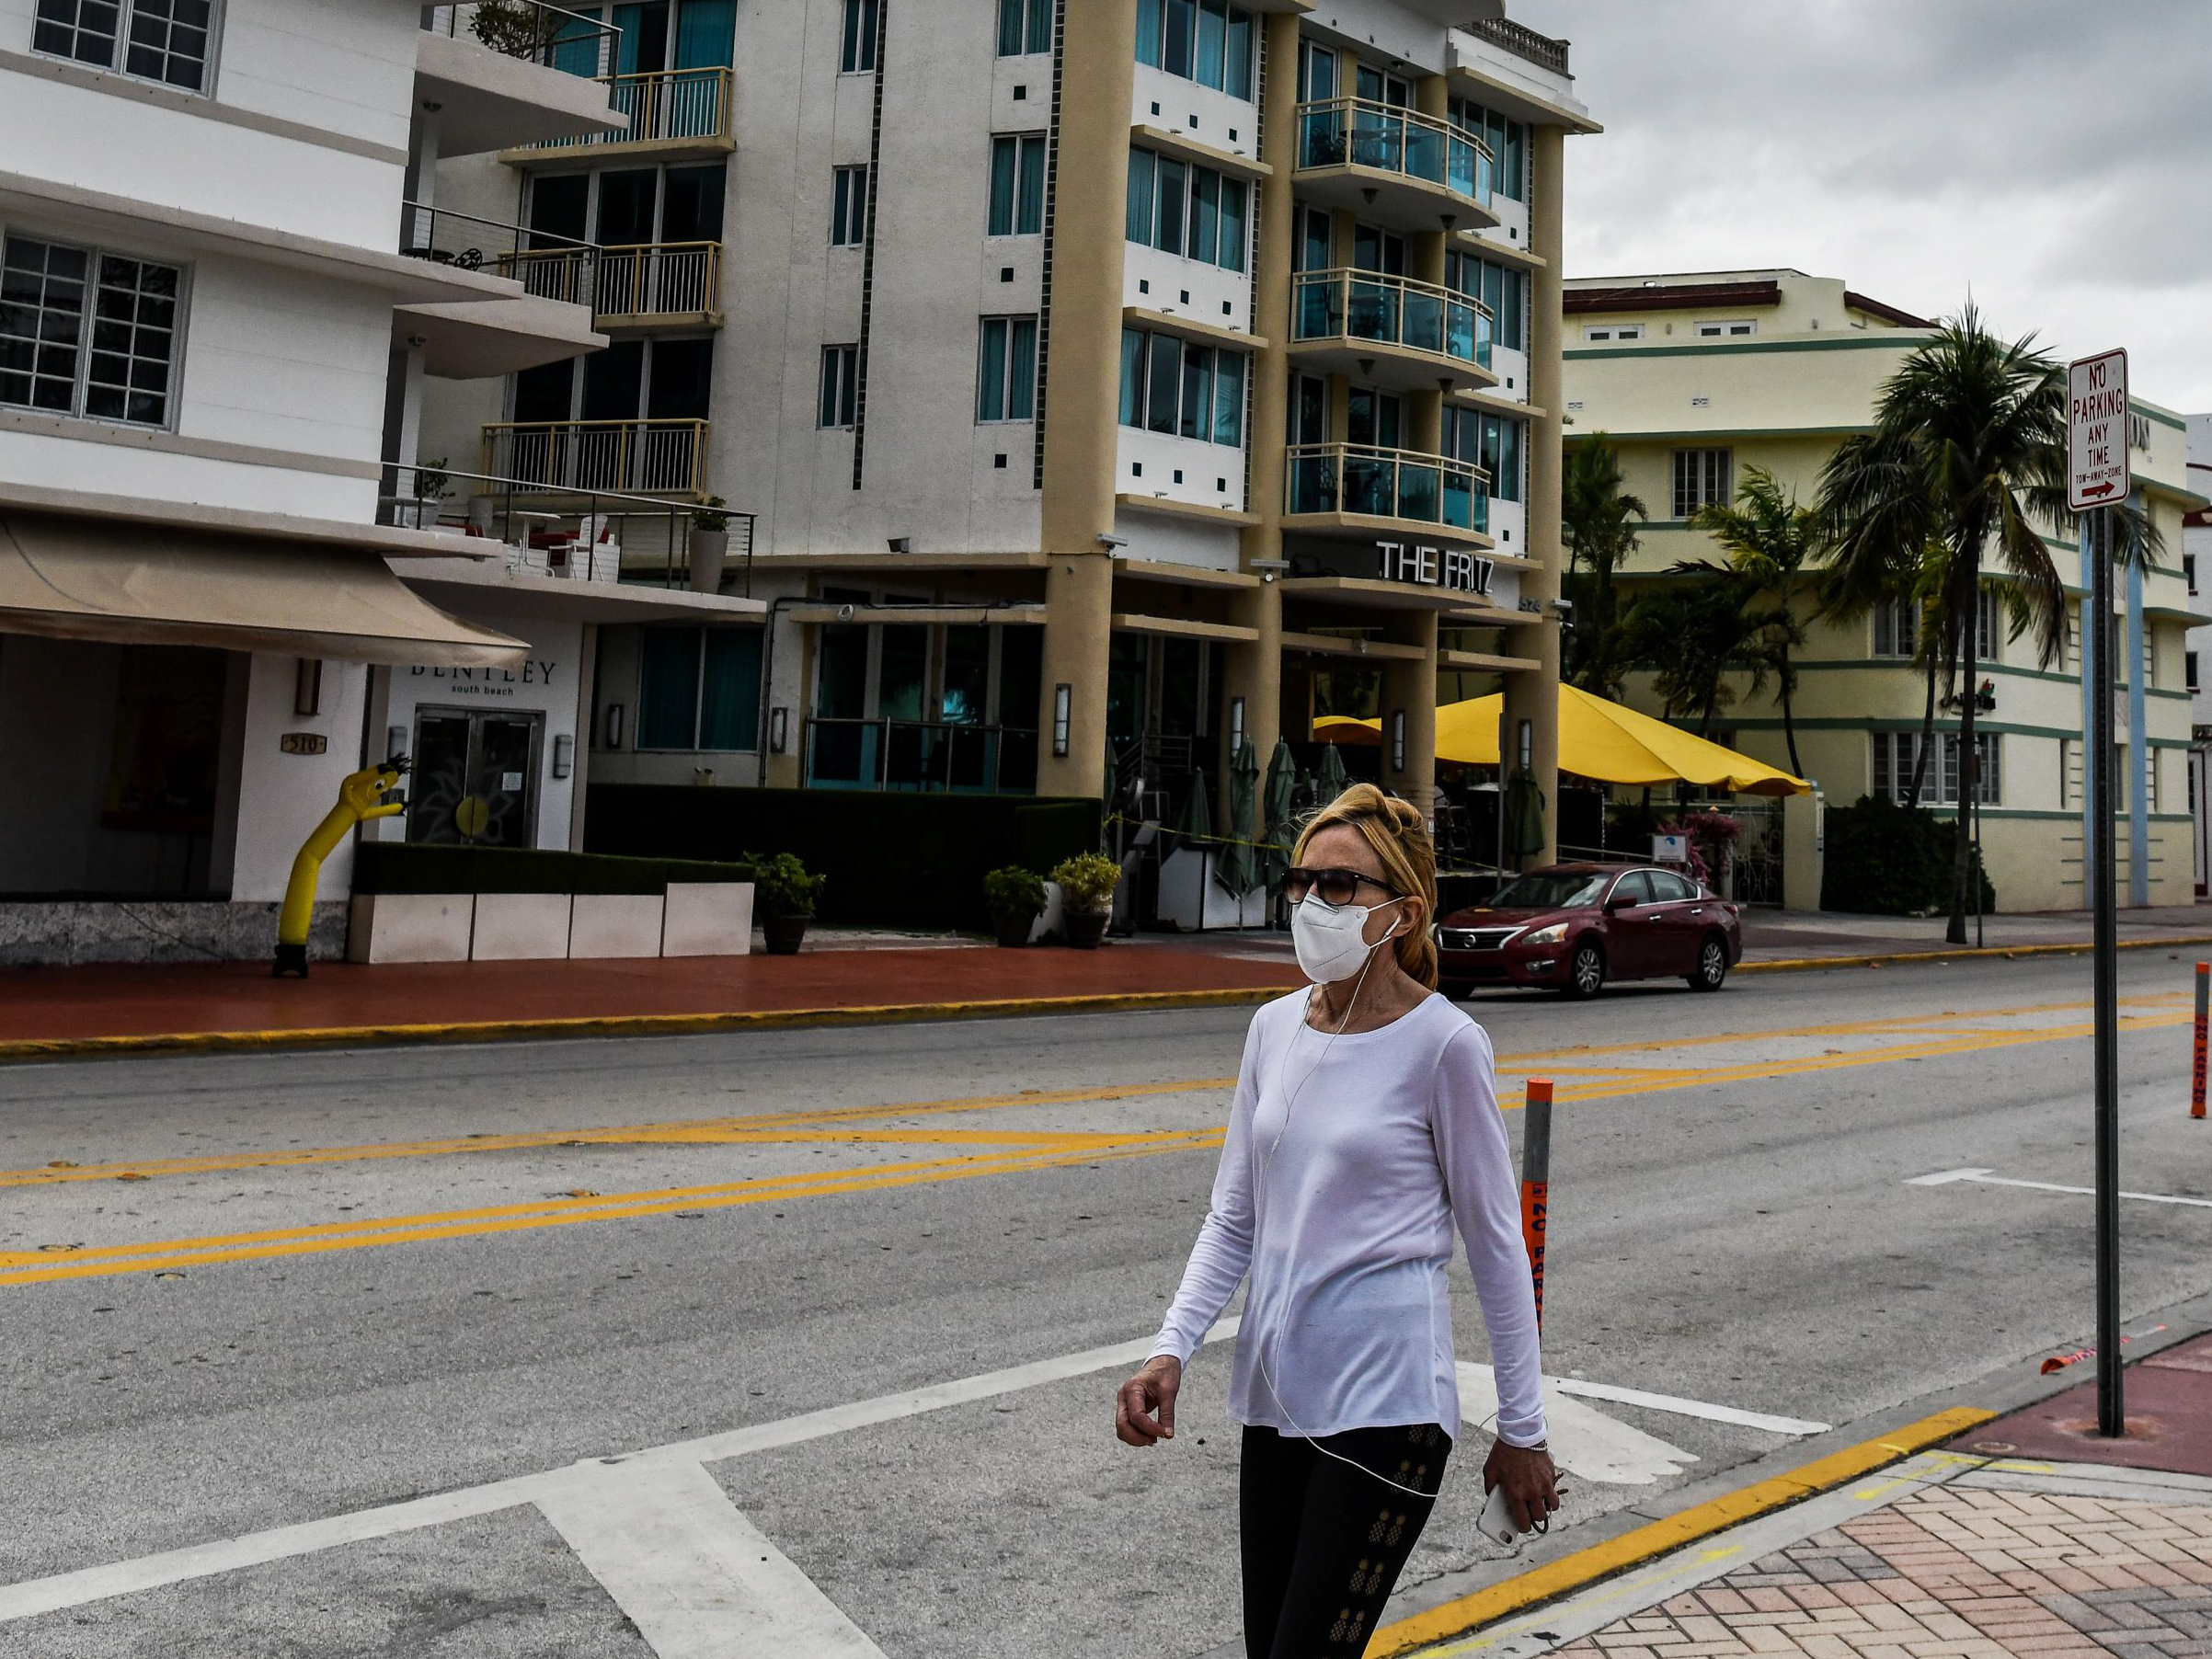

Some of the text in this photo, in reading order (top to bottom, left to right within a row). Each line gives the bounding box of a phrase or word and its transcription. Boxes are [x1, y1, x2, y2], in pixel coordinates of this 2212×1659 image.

[2089, 361, 2106, 391] NO
[2073, 387, 2123, 426] PARKING
[2088, 422, 2109, 445] ANY
[2087, 445, 2110, 468] TIME
[2075, 465, 2122, 485] TOW-AWAY-ZONE
[1376, 541, 1496, 595] THE FRITZ
[451, 684, 514, 696] south beach
[290, 737, 318, 752] 510
